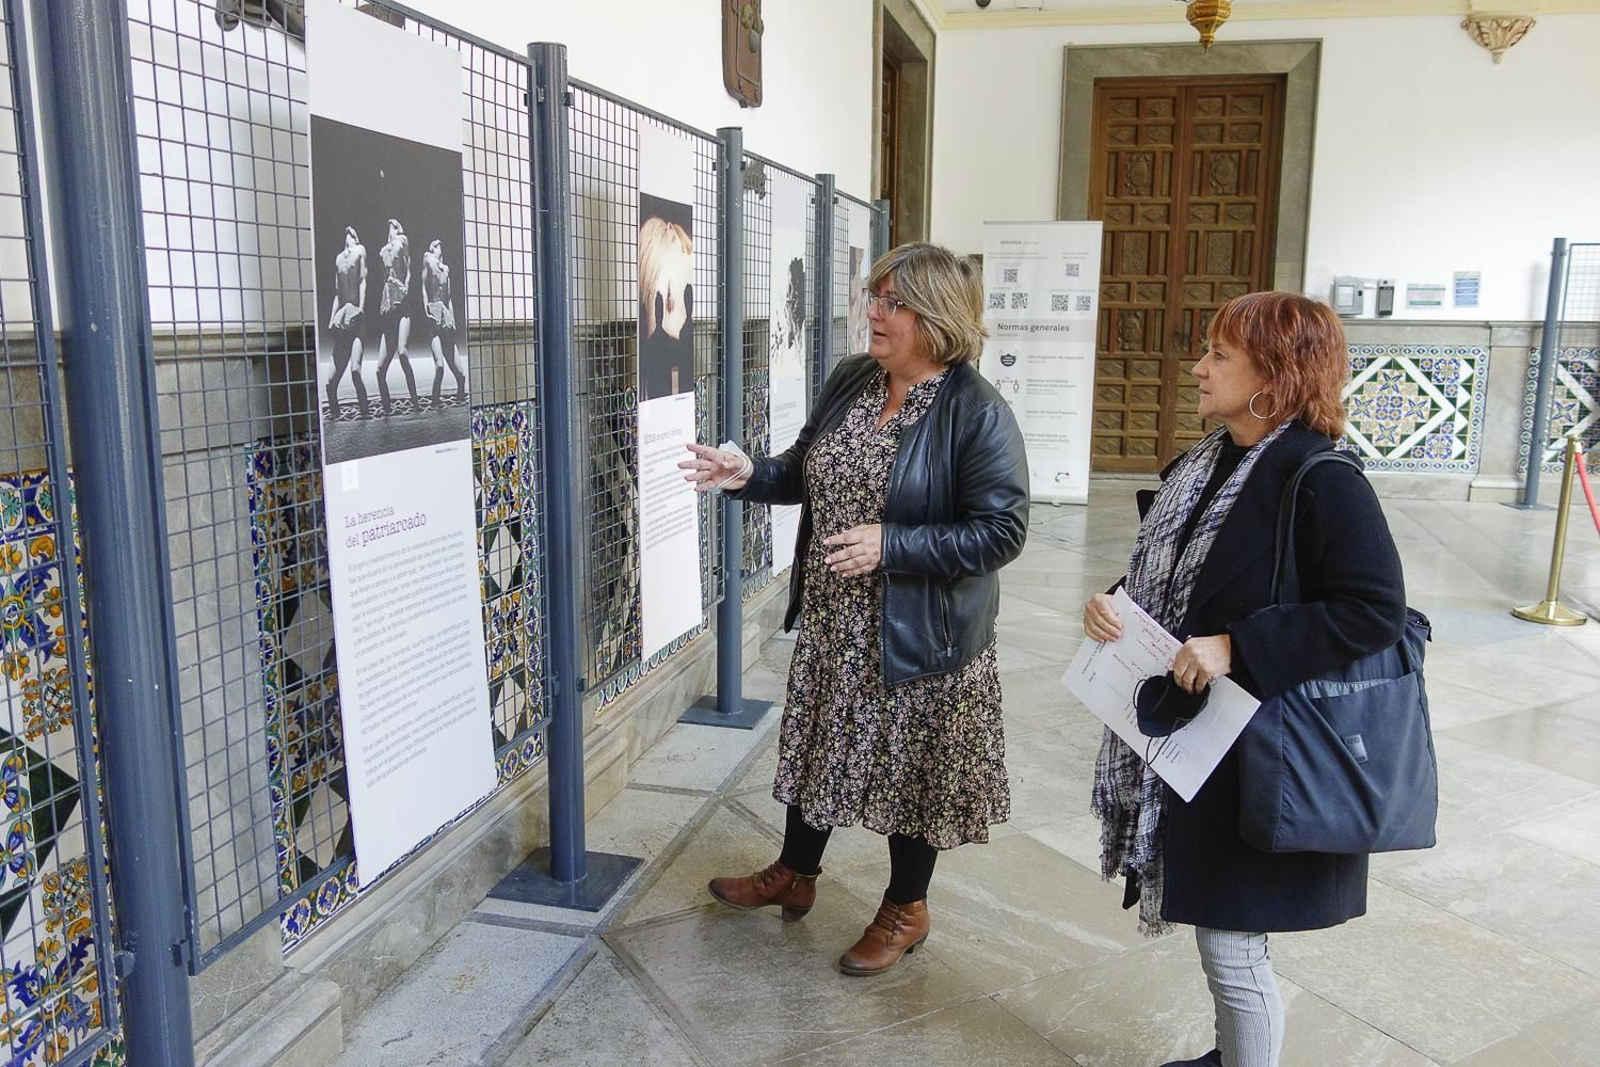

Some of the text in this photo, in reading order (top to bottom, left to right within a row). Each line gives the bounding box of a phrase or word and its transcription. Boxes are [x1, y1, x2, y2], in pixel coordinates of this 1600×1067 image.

[997, 323, 1070, 333] Normas generales
[344, 505, 396, 528] La herencia
[346, 512, 427, 549] del patriarcado
